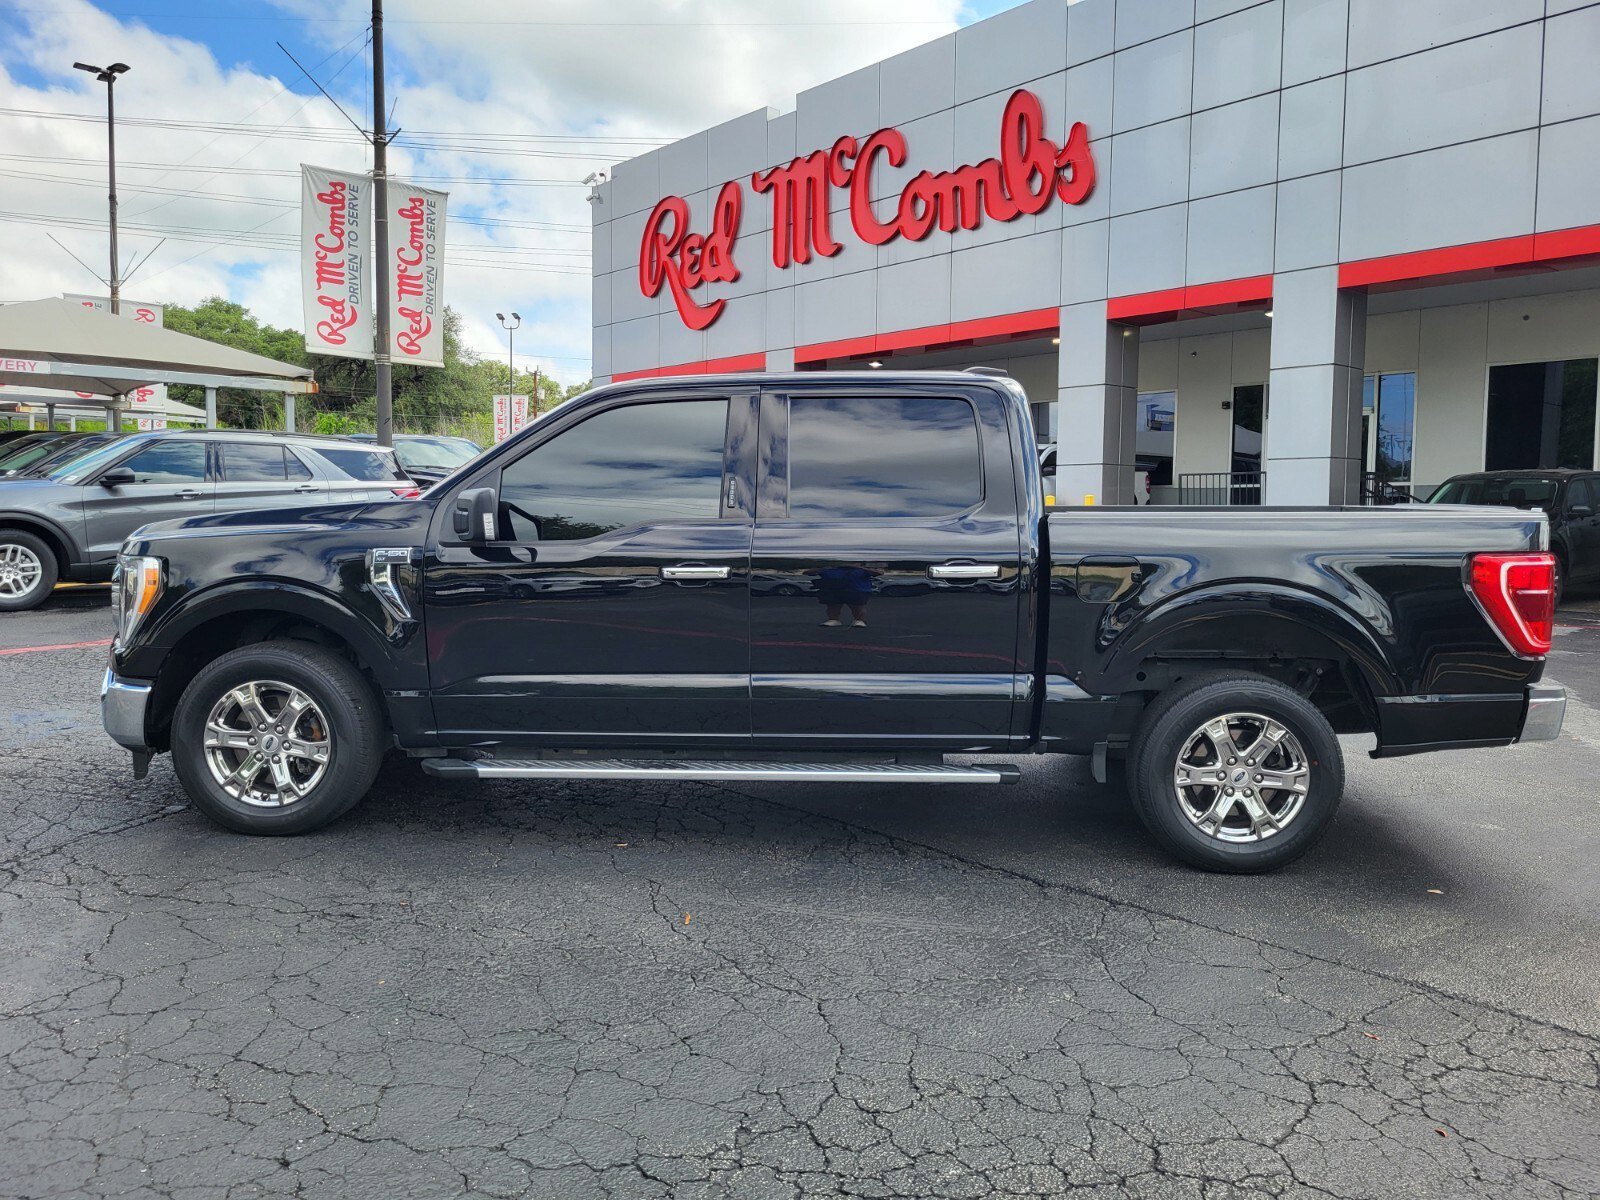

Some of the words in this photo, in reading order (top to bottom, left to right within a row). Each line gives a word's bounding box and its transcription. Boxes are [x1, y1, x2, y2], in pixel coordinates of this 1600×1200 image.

[349, 184, 360, 228] SERVE
[427, 199, 437, 240] SERVE
[639, 181, 743, 331] Red
[751, 89, 1097, 269] McCombs
[314, 181, 346, 291] McCombs
[348, 233, 359, 249] TO
[396, 197, 425, 303] McCombs
[426, 245, 436, 261] TO
[349, 254, 359, 305] DRIVEN
[425, 265, 435, 315] DRIVEN
[316, 295, 358, 346] Red
[396, 306, 432, 355] Red
